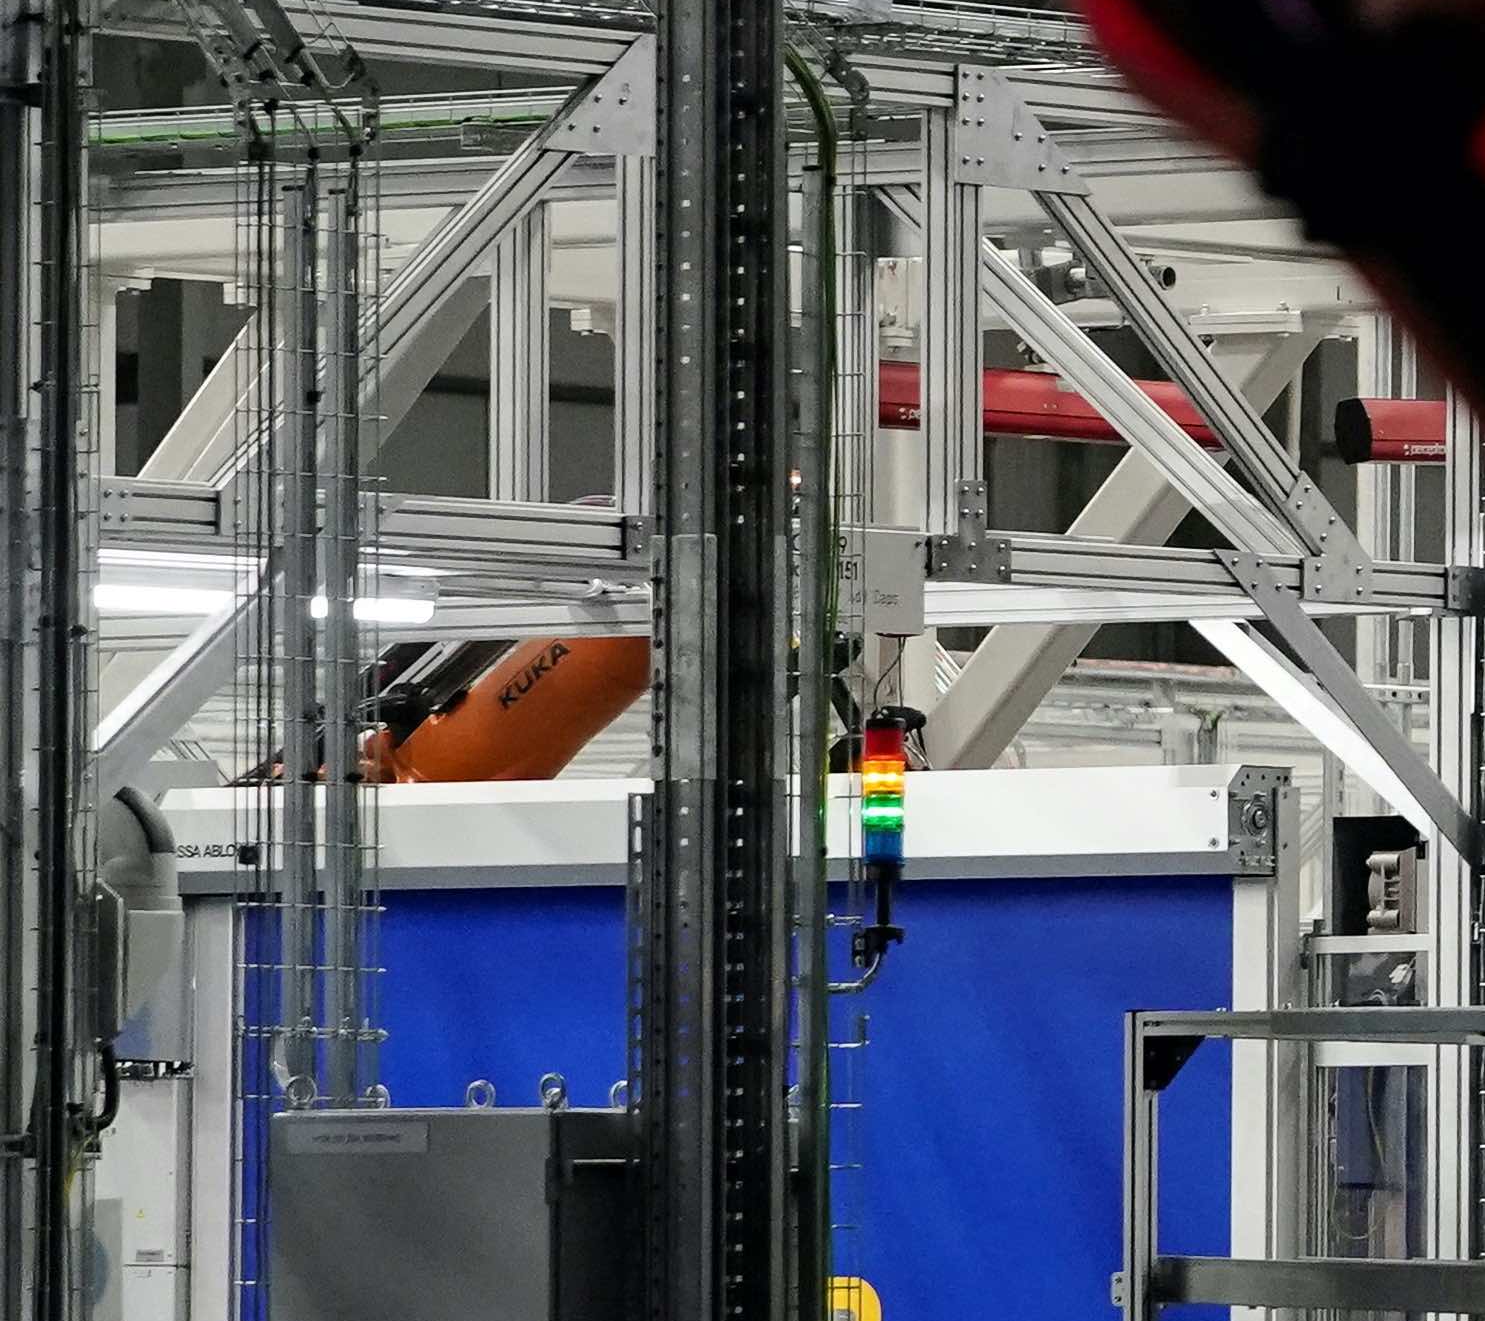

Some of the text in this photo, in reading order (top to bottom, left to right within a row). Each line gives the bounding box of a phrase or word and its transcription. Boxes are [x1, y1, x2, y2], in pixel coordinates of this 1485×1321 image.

[499, 640, 571, 711] KUKA
[176, 843, 240, 858] SSA ABLO
